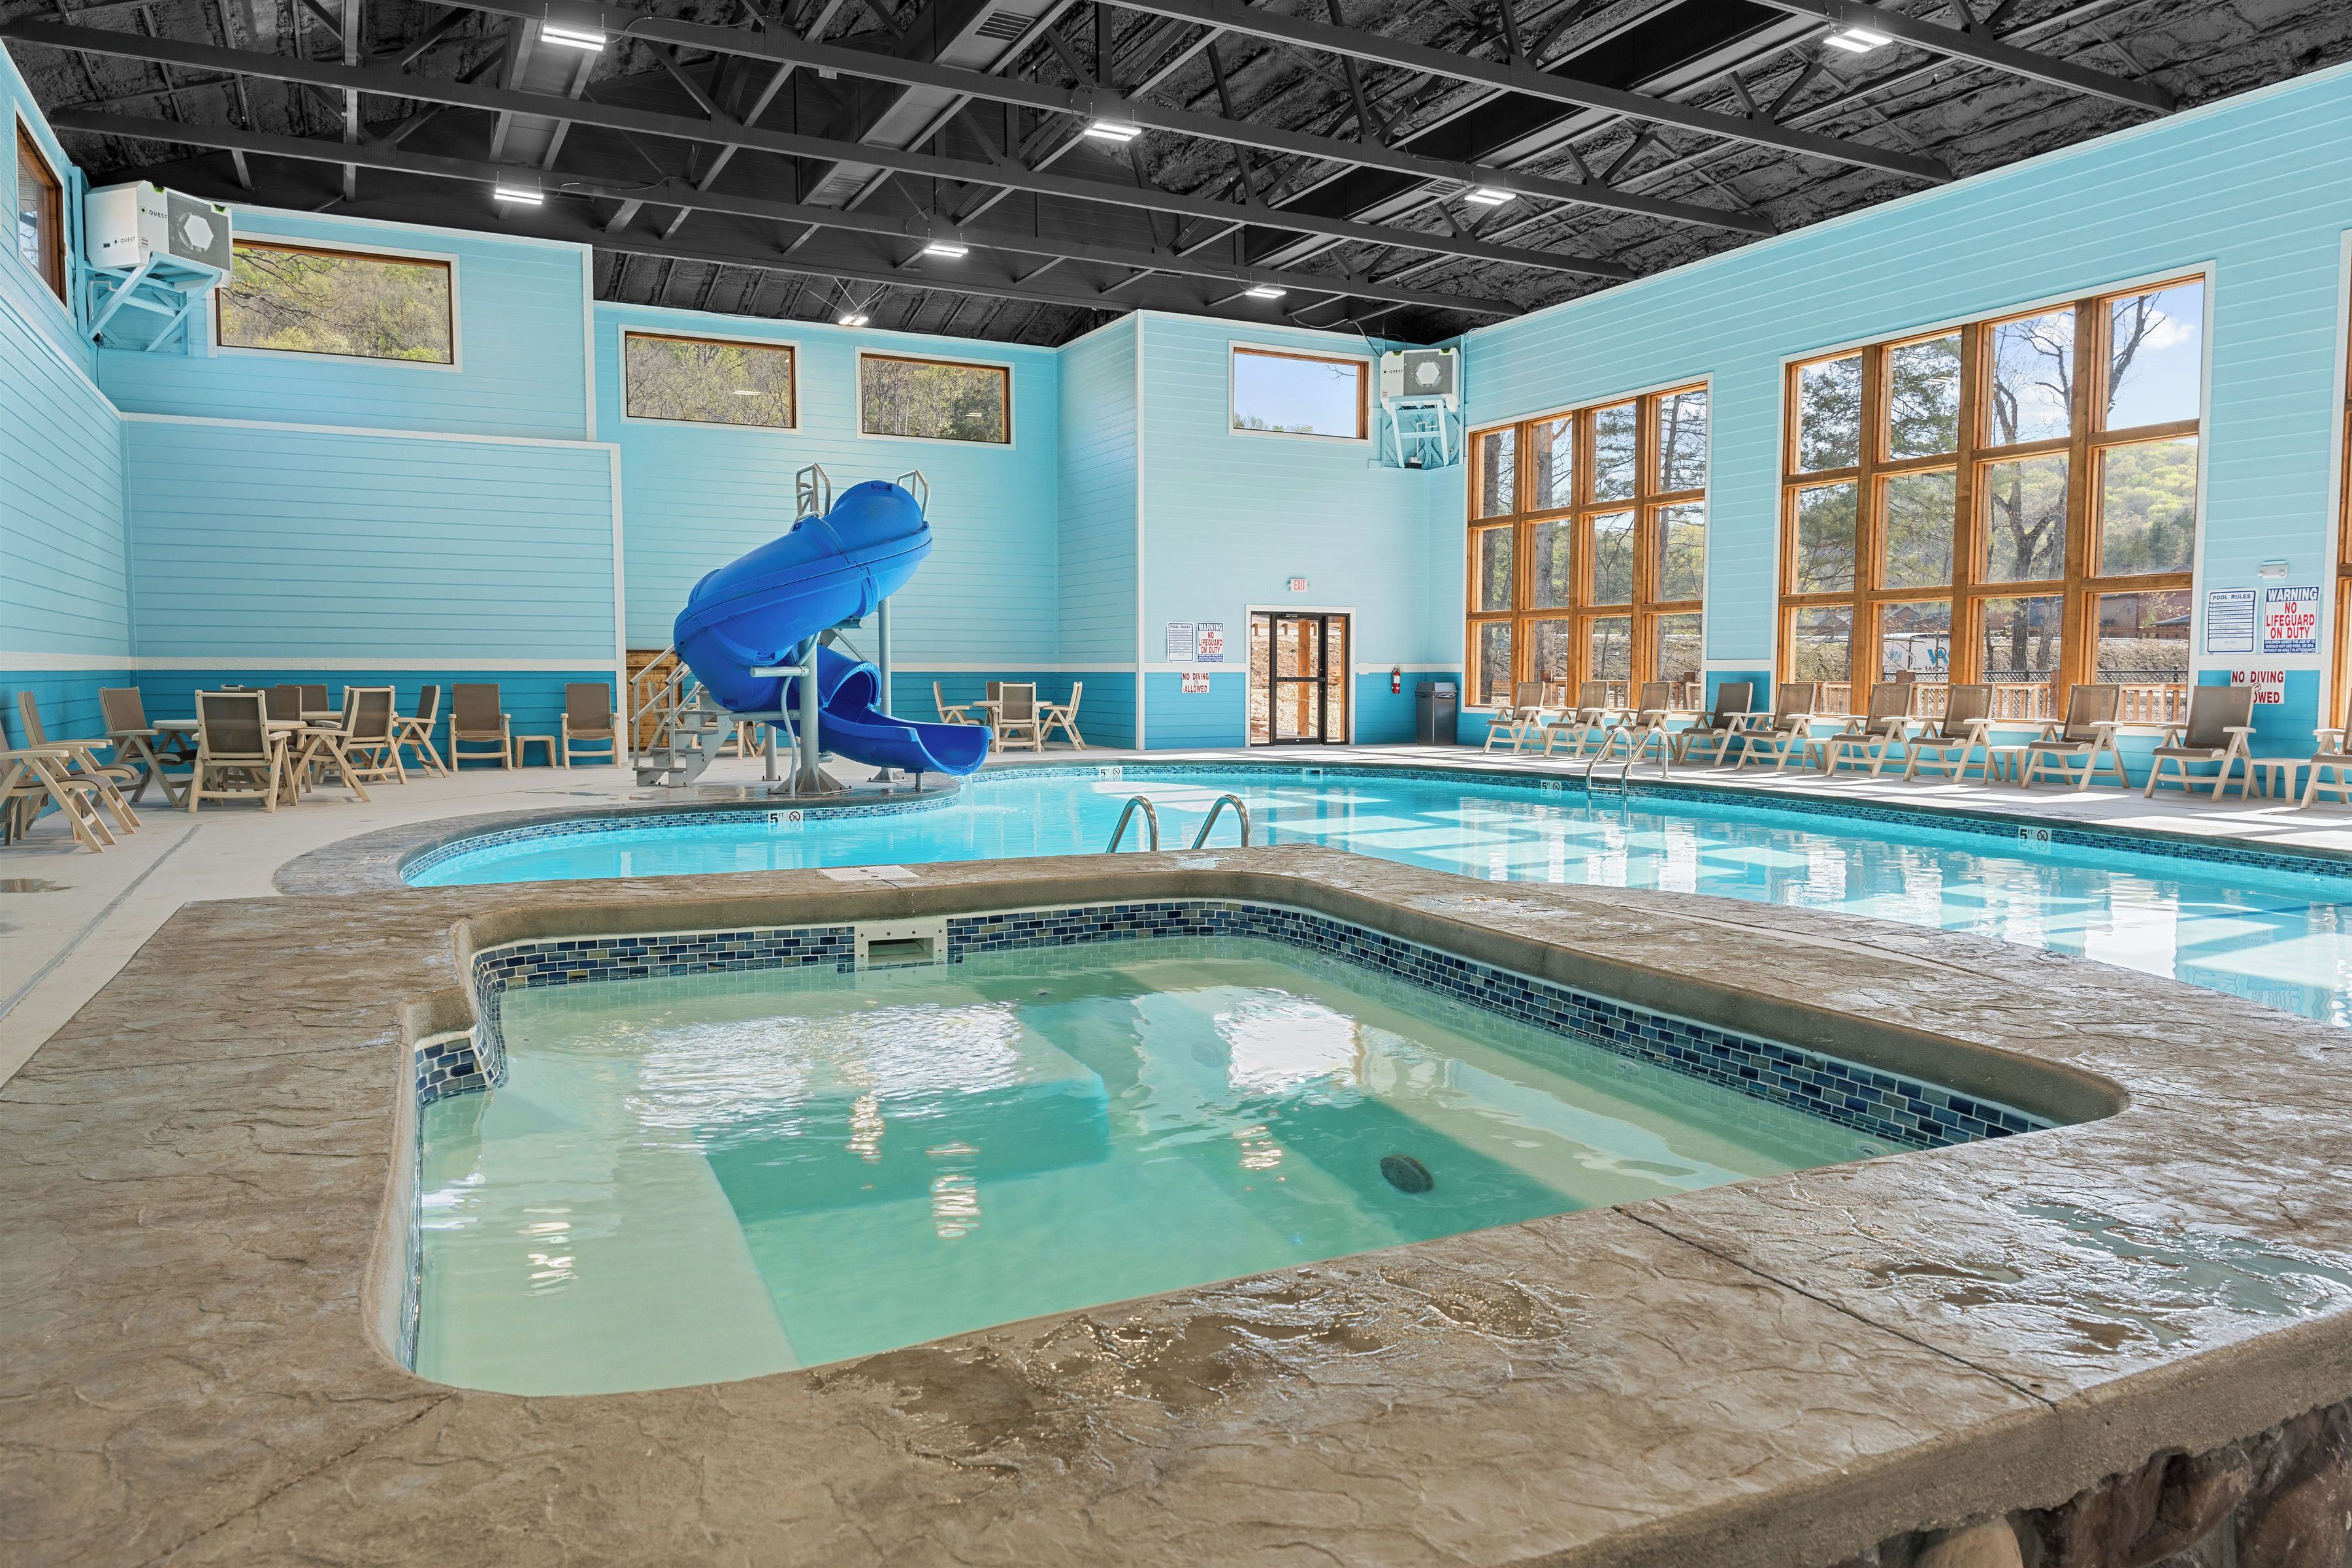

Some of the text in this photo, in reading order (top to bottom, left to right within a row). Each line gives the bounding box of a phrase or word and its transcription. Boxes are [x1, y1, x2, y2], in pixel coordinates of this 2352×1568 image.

[148, 210, 167, 219] QUEST
[1294, 580, 1306, 591] EXIT
[2268, 587, 2317, 602] WARNING
[2285, 602, 2297, 613] NO
[2266, 614, 2315, 627] LIFEGUARD
[2270, 627, 2310, 639] ON DUTY
[2232, 670, 2283, 683] NO DIVING
[770, 813, 779, 823] 5
[2019, 828, 2028, 840] 5
